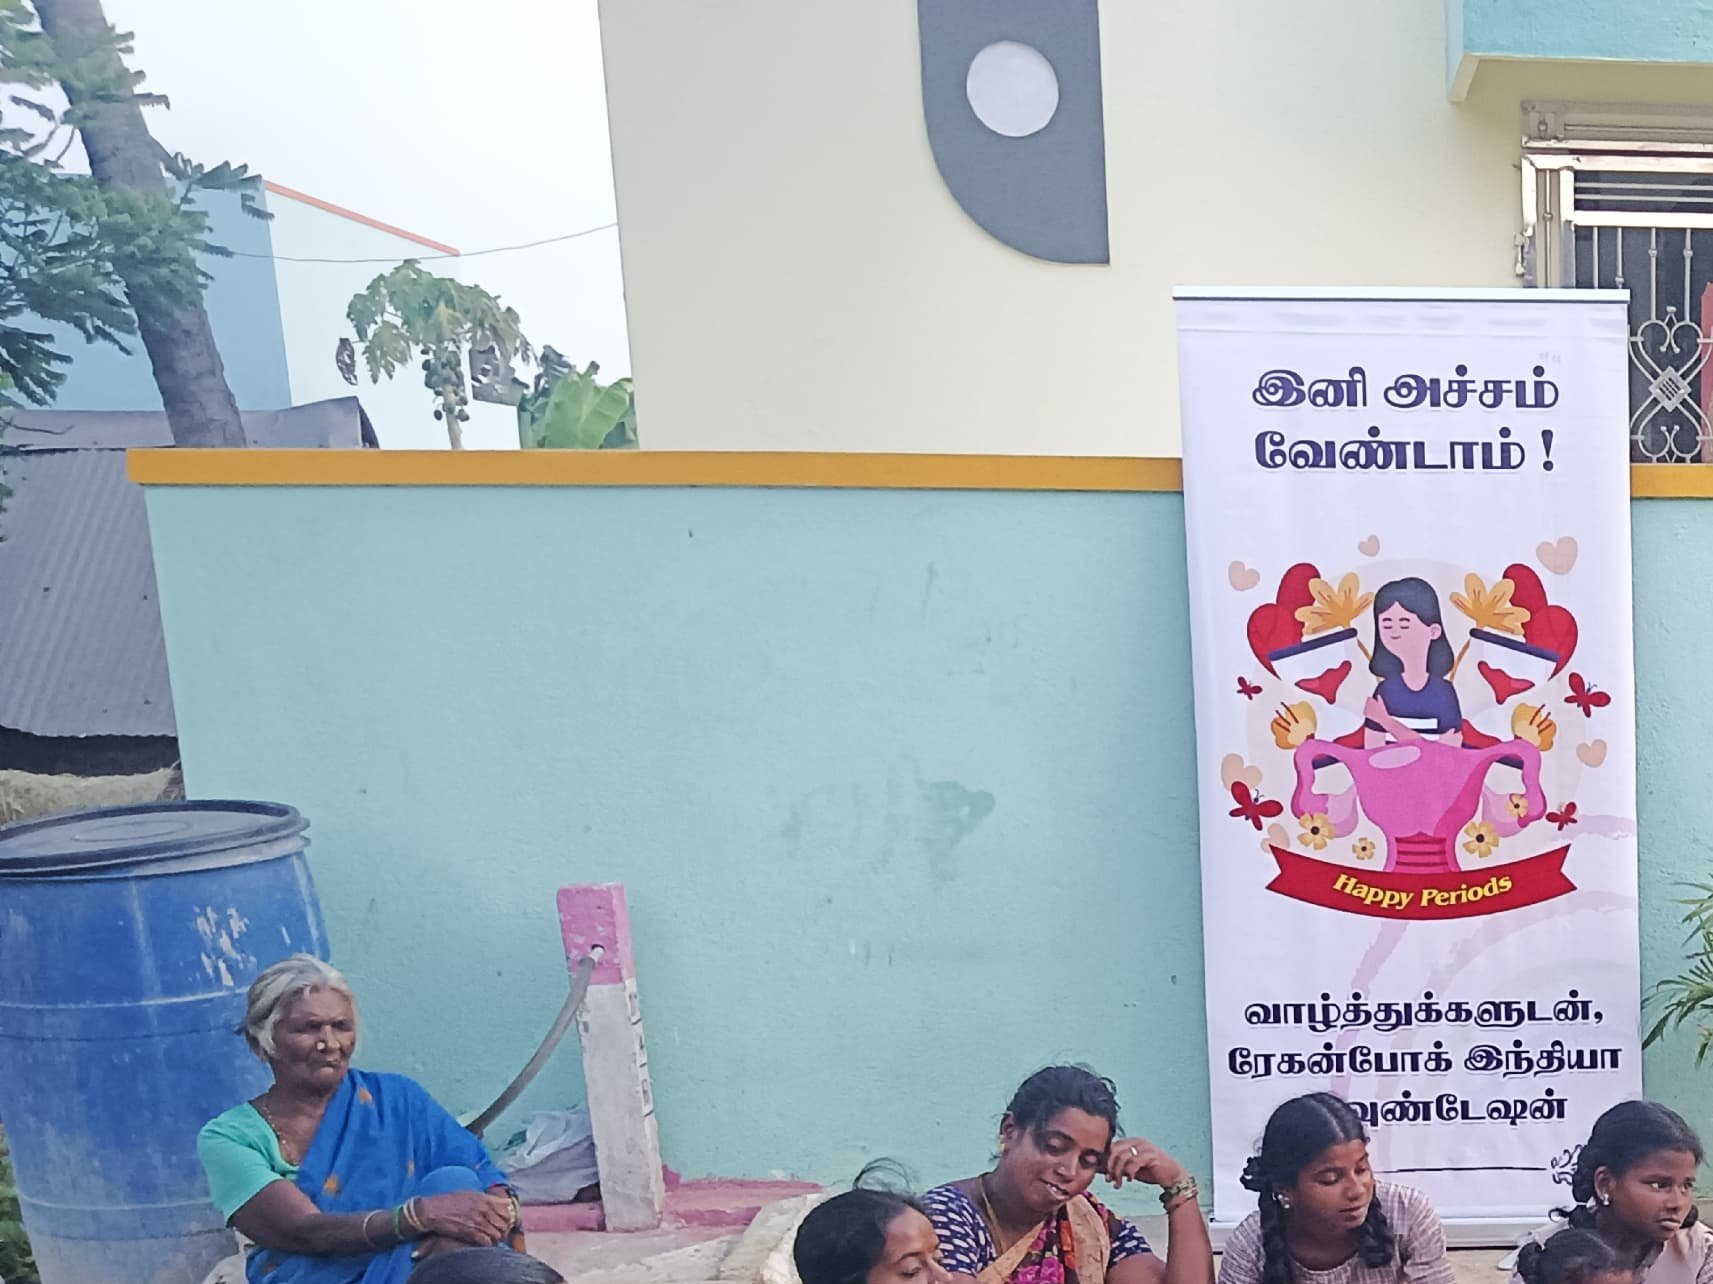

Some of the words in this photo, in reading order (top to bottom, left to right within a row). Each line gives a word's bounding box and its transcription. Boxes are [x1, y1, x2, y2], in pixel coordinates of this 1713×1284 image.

[1252, 366, 1367, 408] இனி
[1383, 364, 1559, 409] அச்சம்
[1254, 425, 1526, 470] வேண்டாம்
[1333, 873, 1413, 910] Happy
[1420, 875, 1513, 907] Periods
[1244, 988, 1604, 1033] வாழ்த்துக்களுடன்,
[1227, 1040, 1453, 1080] ரேகன்போக்
[1463, 1039, 1623, 1079] இந்தியா
[1348, 1087, 1569, 1128] வுண்டேஷன்
